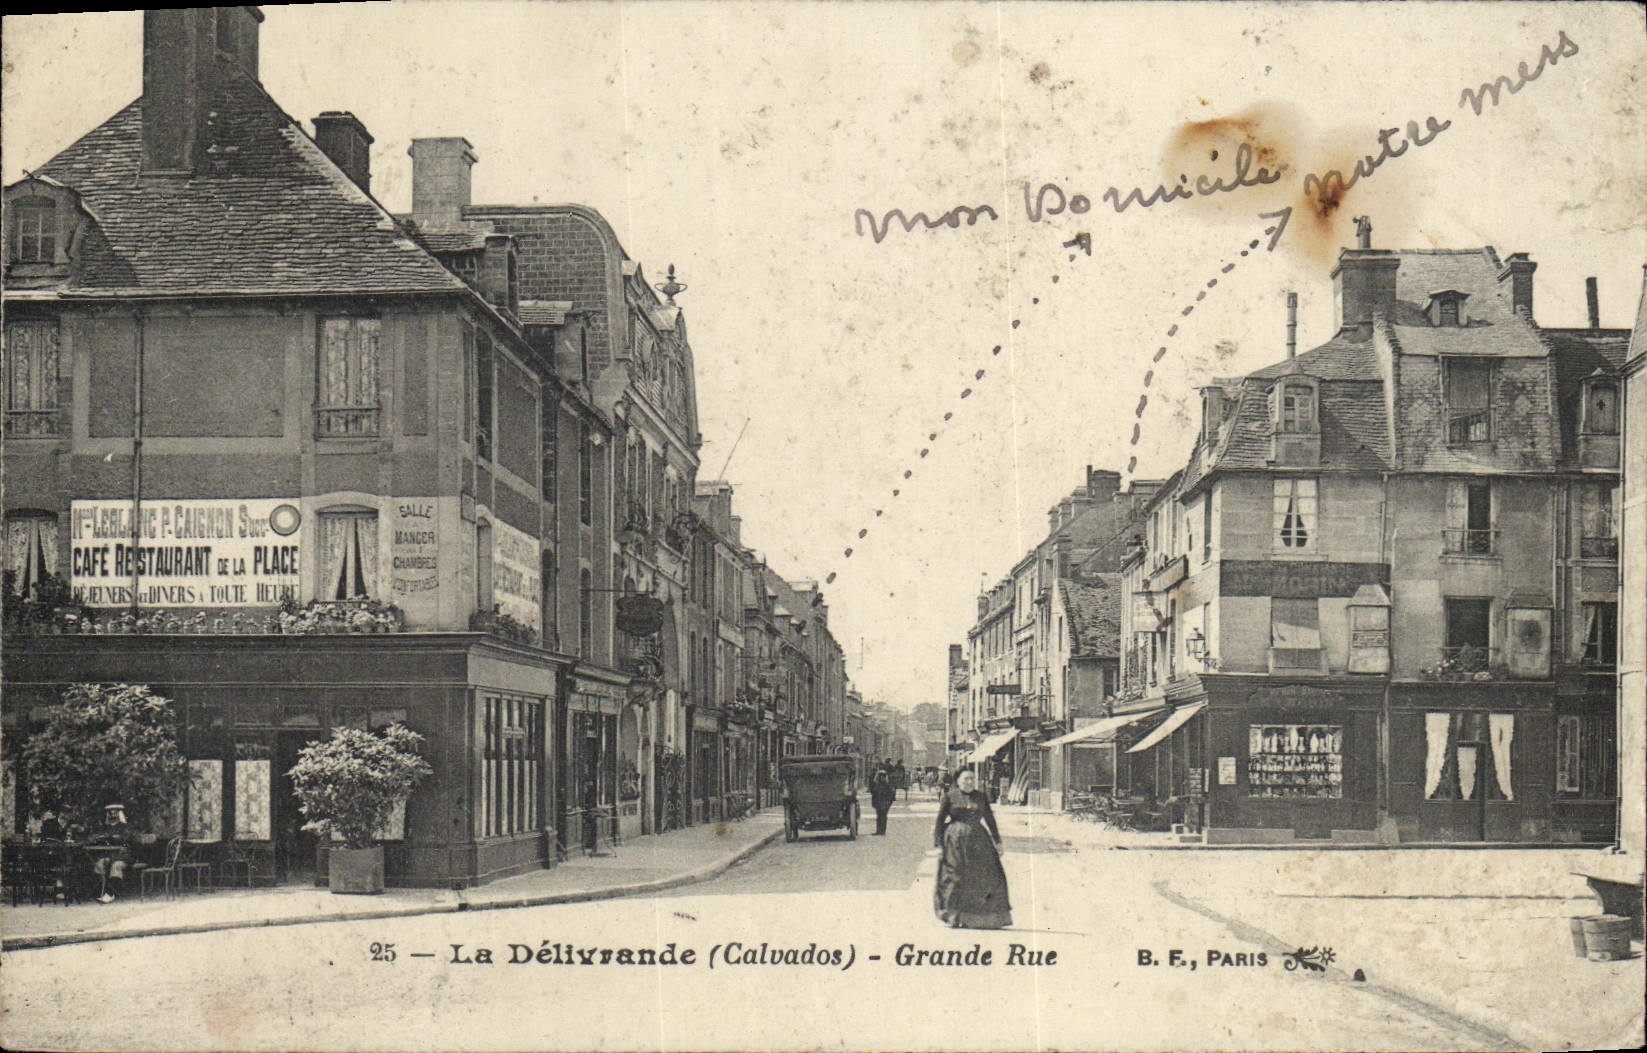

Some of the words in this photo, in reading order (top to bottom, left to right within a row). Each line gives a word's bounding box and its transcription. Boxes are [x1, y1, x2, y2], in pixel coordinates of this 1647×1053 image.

[1304, 116, 1452, 200] notre
[1458, 30, 1579, 116] mess
[399, 503, 433, 519] SALLE
[394, 530, 435, 545] MANGER
[73, 544, 109, 577] CAFÉ
[115, 543, 211, 577] RESTAURANT
[217, 558, 229, 575] DE
[233, 557, 246, 575] LA
[253, 545, 298, 575] PLACE
[393, 556, 437, 569] CHAMBRES
[148, 585, 196, 603] DINERS
[209, 584, 248, 604] TOUTE
[256, 583, 299, 603] HEURE
